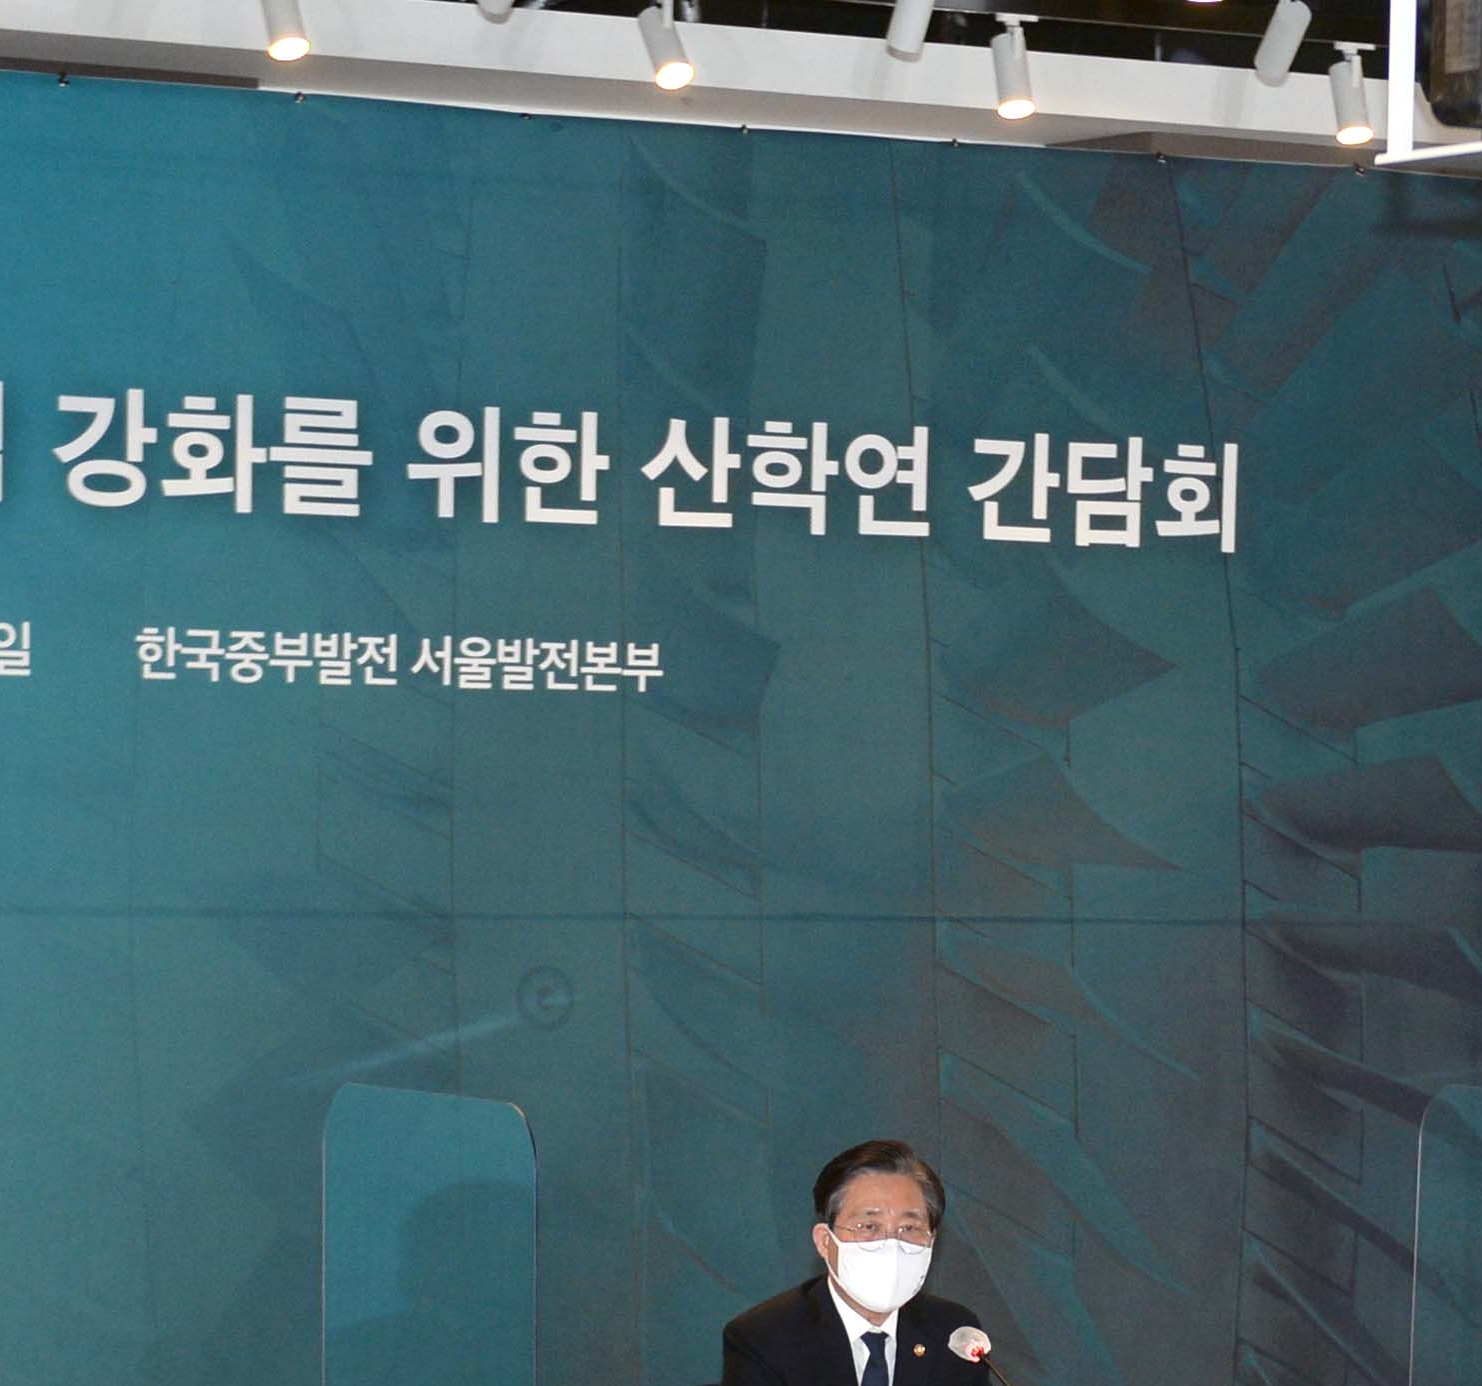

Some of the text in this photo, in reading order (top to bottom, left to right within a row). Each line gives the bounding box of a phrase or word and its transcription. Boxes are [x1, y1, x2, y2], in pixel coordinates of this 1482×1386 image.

[53, 389, 372, 516] 강화를
[407, 407, 609, 524] 위한
[641, 417, 929, 536] 산학연
[968, 434, 1238, 553] 간담회
[135, 627, 397, 685] 한국중부발전
[411, 636, 663, 692] 서울발전본부
